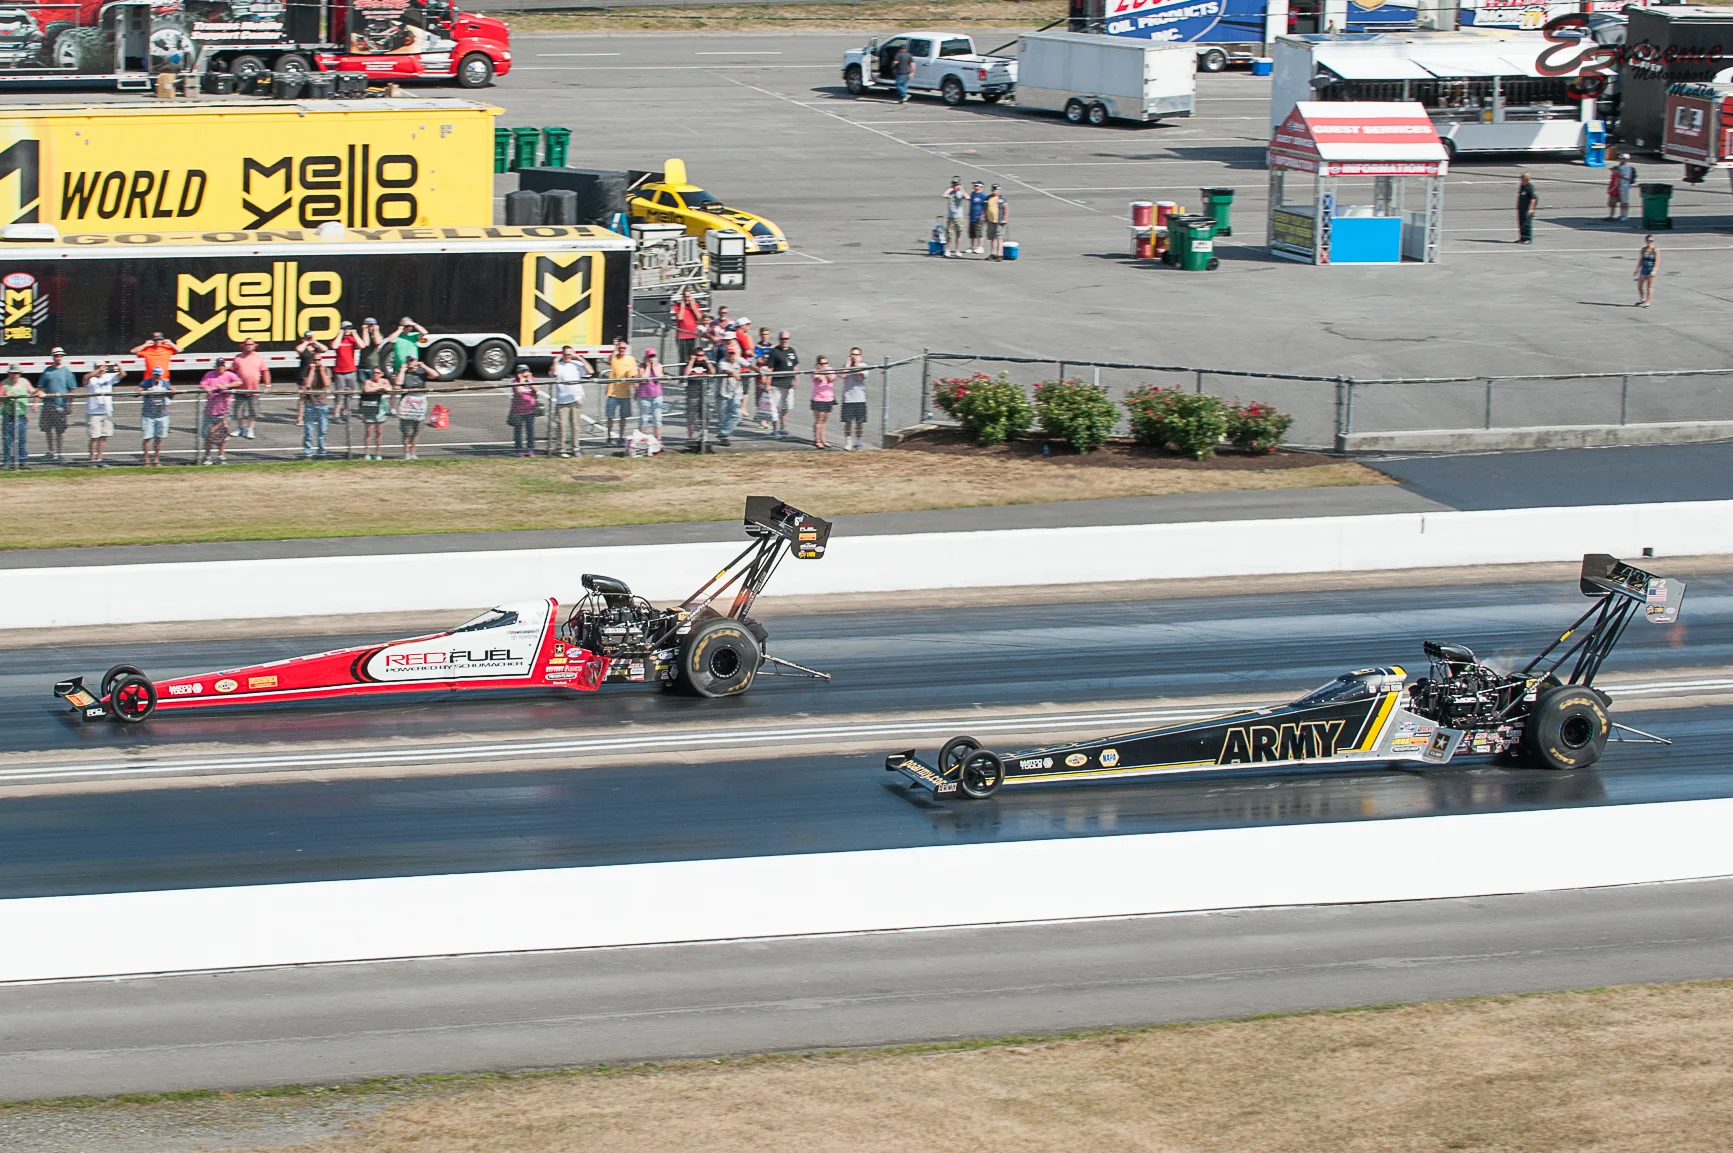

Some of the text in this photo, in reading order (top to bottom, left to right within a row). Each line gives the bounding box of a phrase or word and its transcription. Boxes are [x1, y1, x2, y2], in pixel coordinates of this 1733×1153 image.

[1107, 20, 1136, 34] OIL
[1137, 2, 1219, 29] PRODUCTS
[1151, 28, 1183, 41] INC.
[1312, 125, 1360, 134] GUEST
[1362, 125, 1433, 134] SERVICES
[1341, 164, 1426, 174] INFORMATION
[60, 169, 207, 220] WORLD
[62, 225, 596, 245] GO-ON YELLO!
[385, 649, 523, 667] RED FUEL
[453, 661, 523, 669] SCHUMACHER
[1217, 719, 1346, 765] ARMY
[1102, 753, 1117, 762] NAPA
